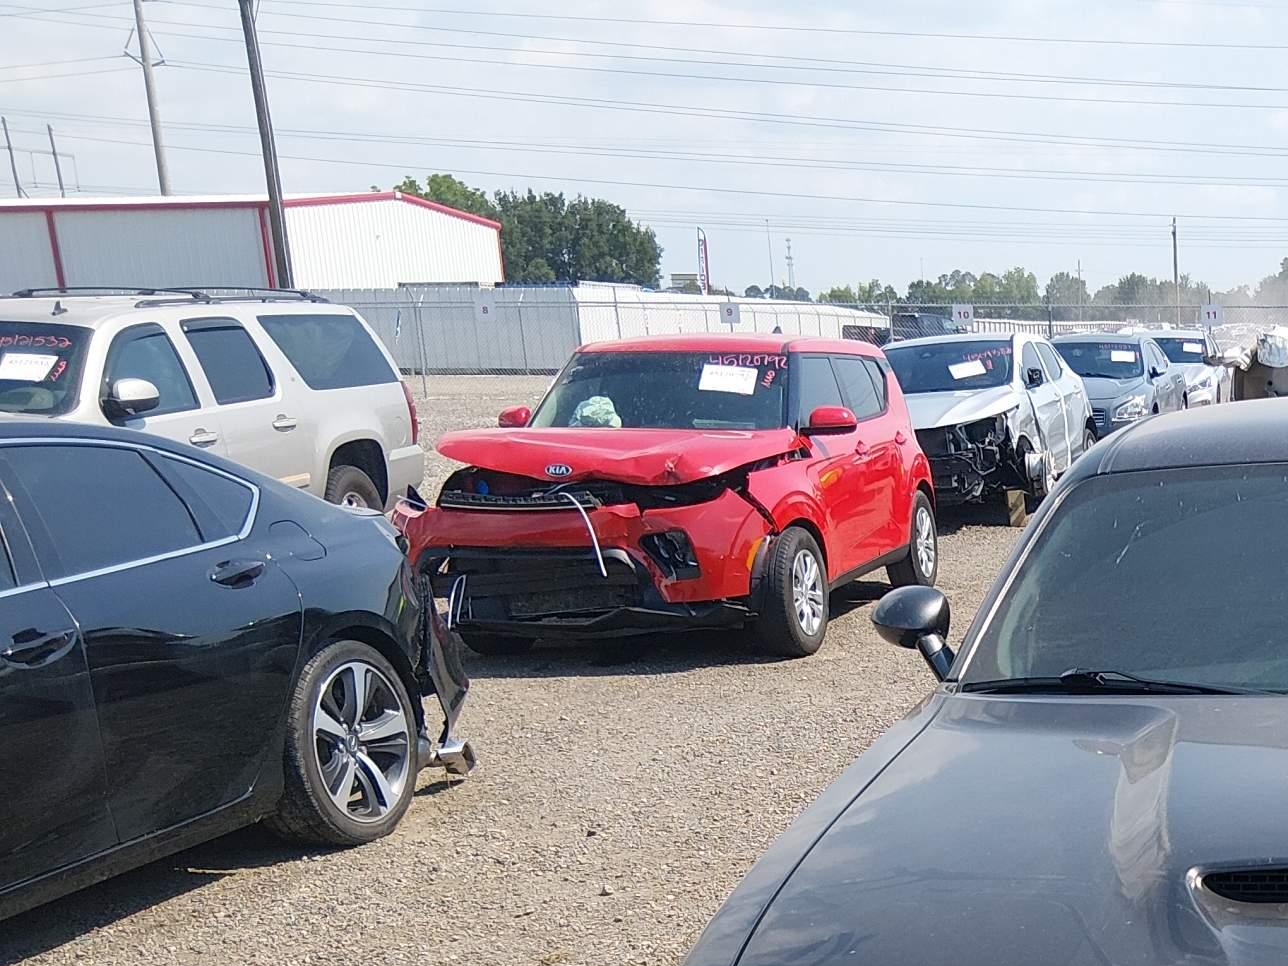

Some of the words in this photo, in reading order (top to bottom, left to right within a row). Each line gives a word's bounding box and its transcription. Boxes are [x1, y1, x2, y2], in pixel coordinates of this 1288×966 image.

[726, 308, 733, 316] 9
[958, 311, 969, 319] 10
[1206, 311, 1217, 320] 11
[549, 466, 567, 474] KIA
